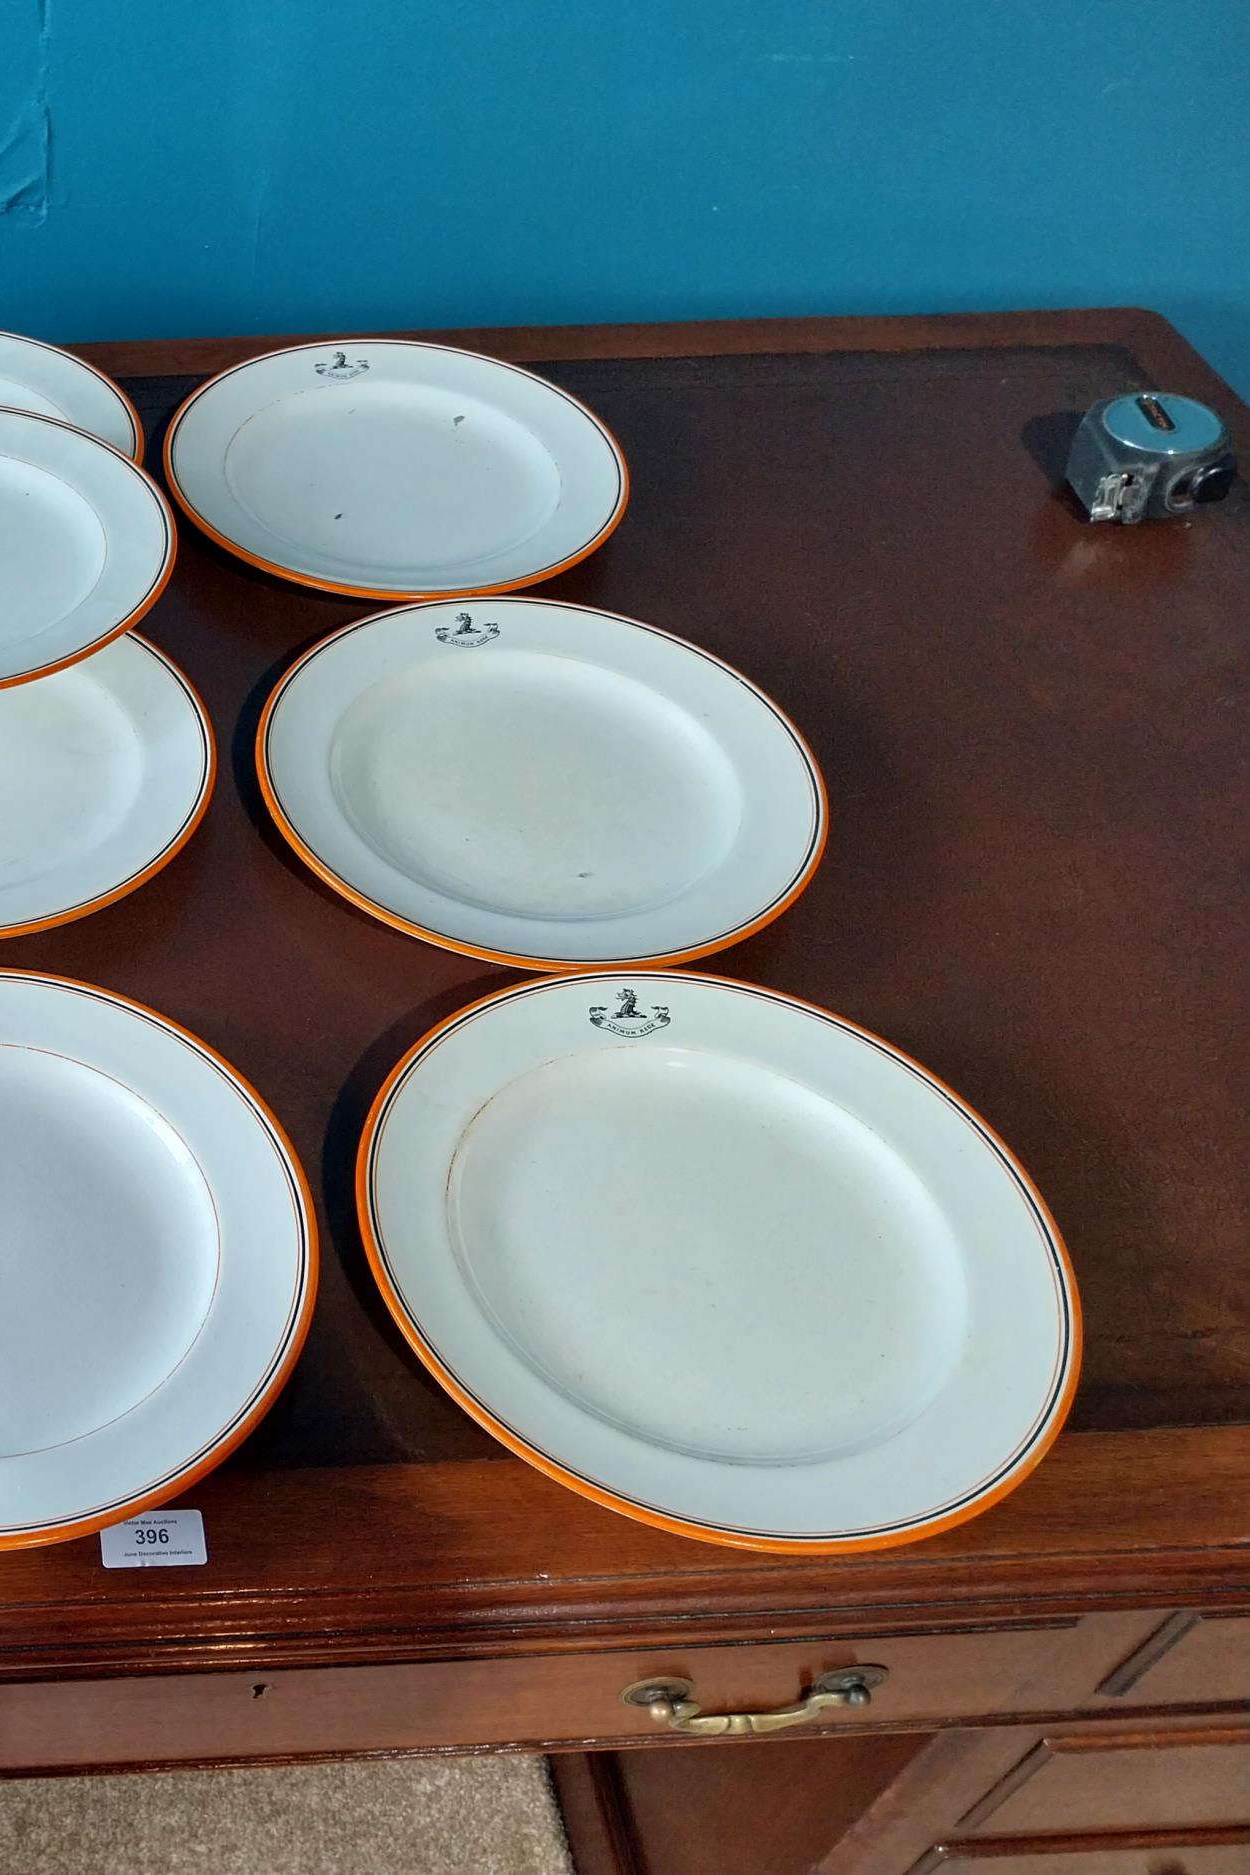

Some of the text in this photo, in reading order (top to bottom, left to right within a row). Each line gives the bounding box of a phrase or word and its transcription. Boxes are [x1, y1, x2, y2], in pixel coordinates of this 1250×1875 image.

[607, 1023, 656, 1034] ANIMUM REGE
[135, 1529, 169, 1544] 396
